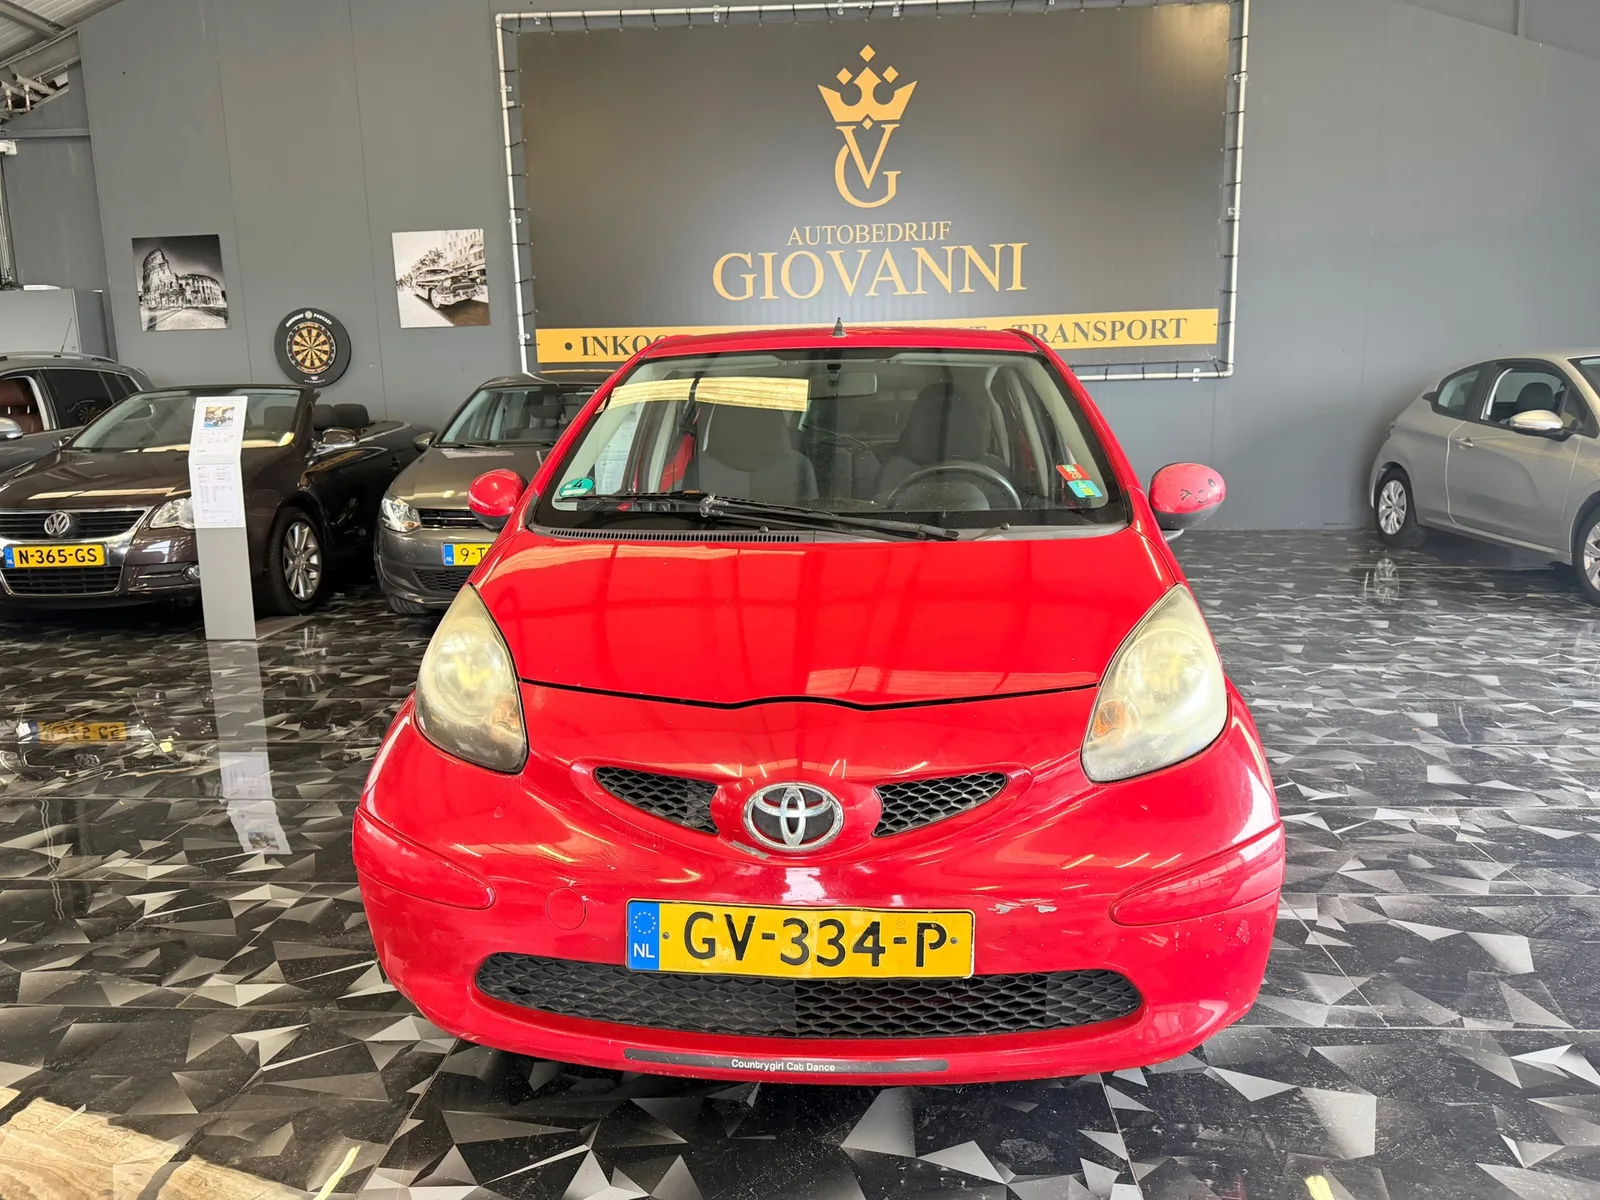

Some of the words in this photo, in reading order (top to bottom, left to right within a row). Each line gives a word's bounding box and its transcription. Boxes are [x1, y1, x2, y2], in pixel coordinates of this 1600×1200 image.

[787, 221, 951, 246] AUTOBEDRIJF
[712, 243, 1028, 301] GIOVANNI
[581, 335, 669, 356] INKO
[19, 548, 97, 564] N-365-GS
[461, 547, 490, 561] 9-T
[633, 942, 655, 959] NL
[684, 911, 947, 967] GV-334-P
[731, 1059, 784, 1072] Countrygirl
[786, 1062, 804, 1071] Cat
[806, 1063, 836, 1072] Dance
